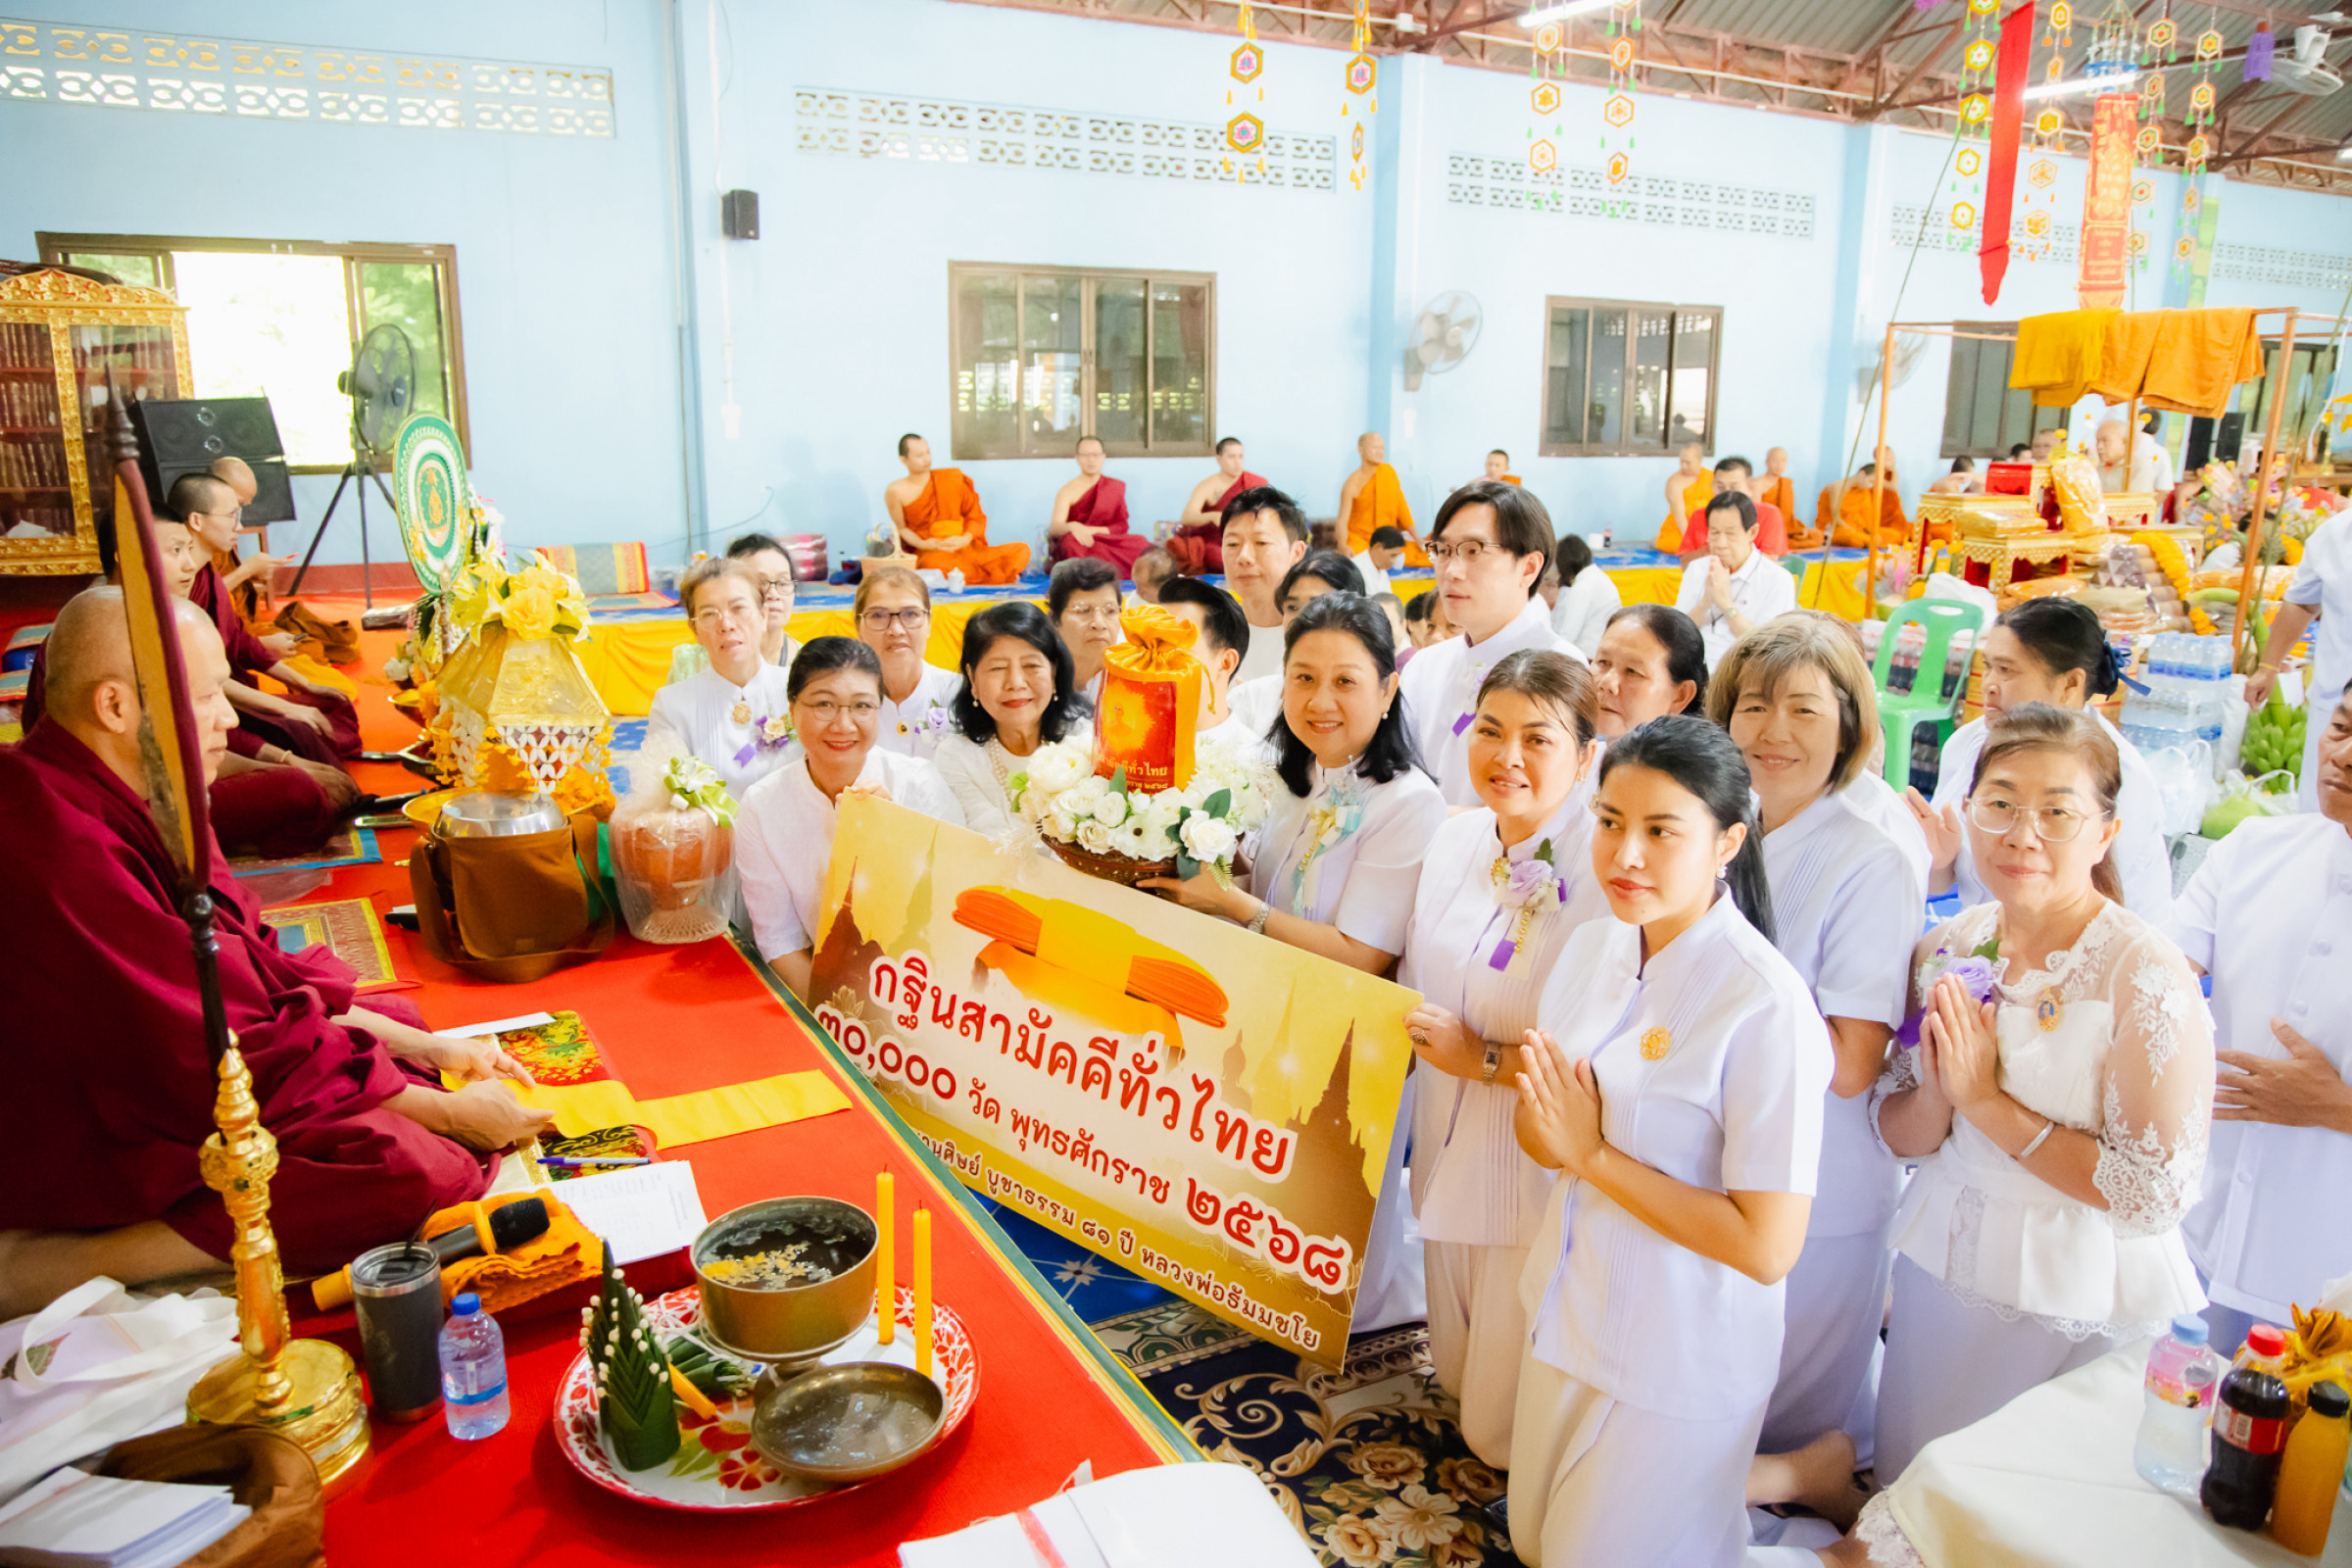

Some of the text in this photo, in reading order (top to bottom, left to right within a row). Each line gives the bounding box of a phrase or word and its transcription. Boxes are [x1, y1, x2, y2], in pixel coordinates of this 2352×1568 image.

[818, 1010, 1346, 1286] ๓๐,๐๐๐ วัด พุทธศักราช ๒๕๖๘
[874, 956, 1289, 1175] กฐินสามัคคีทั่วไทย
[987, 1168, 1074, 1226] บูชาธรรม
[1082, 1220, 1110, 1245] ๘๑
[1118, 1230, 1133, 1255] ปี
[1141, 1247, 1318, 1349] หลวงพ่อธัมมชโย
